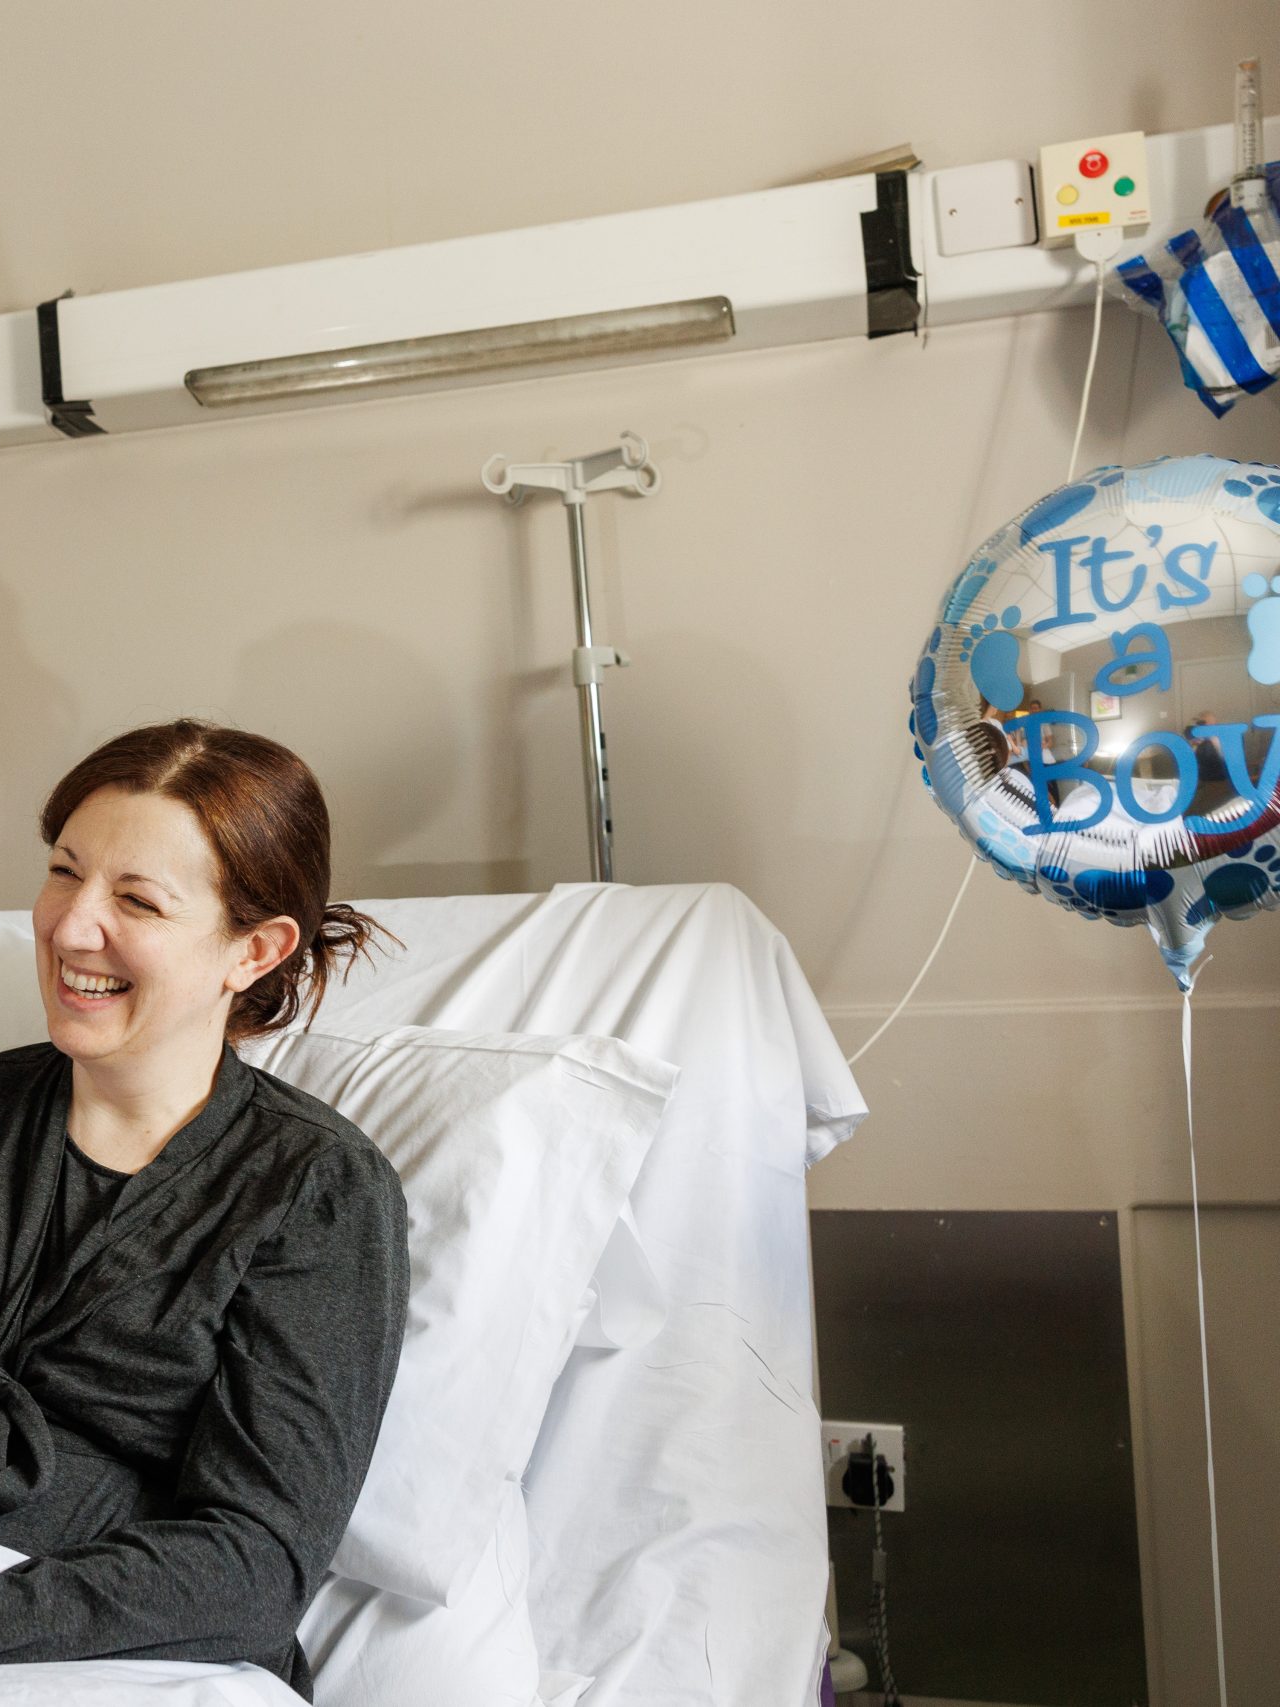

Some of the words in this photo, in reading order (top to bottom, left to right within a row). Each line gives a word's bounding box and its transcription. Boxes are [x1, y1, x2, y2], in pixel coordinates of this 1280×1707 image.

[1033, 525, 1218, 632] It's
[1096, 621, 1172, 696] a
[1005, 709, 1280, 836] Boy
